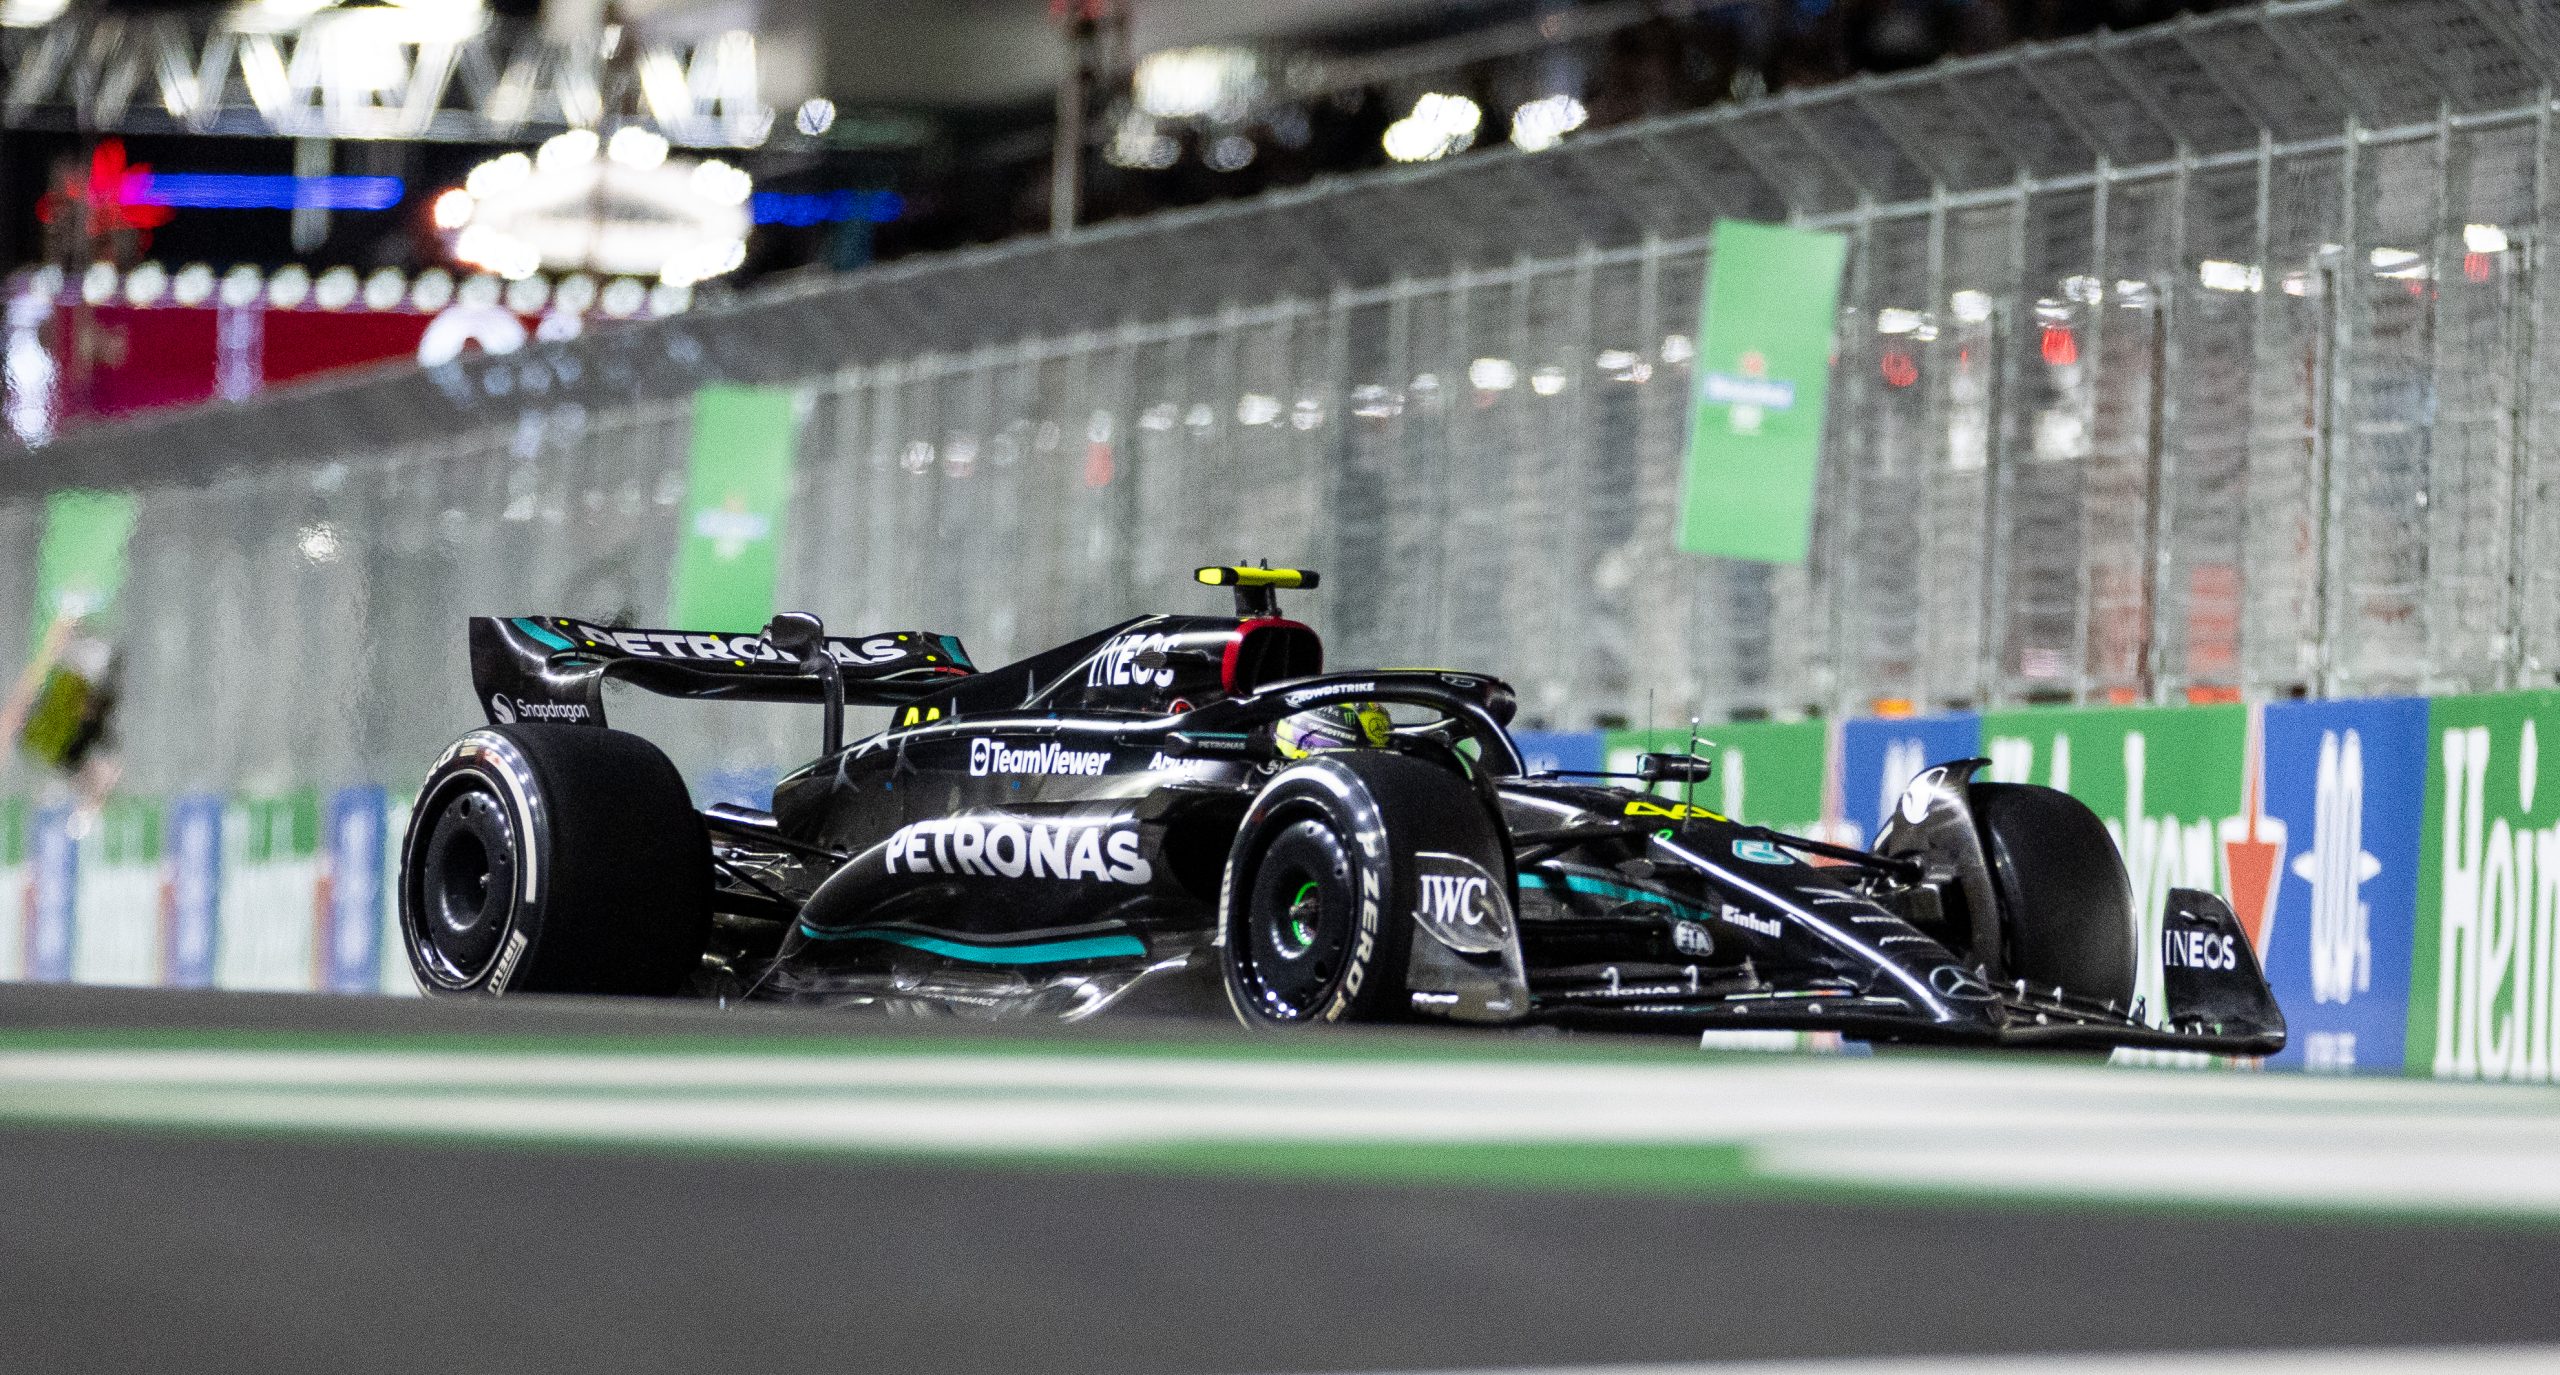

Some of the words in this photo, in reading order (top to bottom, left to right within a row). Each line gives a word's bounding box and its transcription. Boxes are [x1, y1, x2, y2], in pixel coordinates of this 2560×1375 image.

[516, 698, 590, 724] Snapdragon
[991, 742, 1111, 776] TeamViewer
[1198, 740, 1246, 750] PETRONAS
[1624, 801, 1729, 823] 44
[885, 820, 1152, 885] PETRONAS
[1420, 875, 1487, 926] IWC
[1346, 866, 1380, 997] ZERO
[1676, 924, 1712, 951] FIA
[1721, 903, 1781, 938] Einhell
[2164, 929, 2236, 970] INEOS
